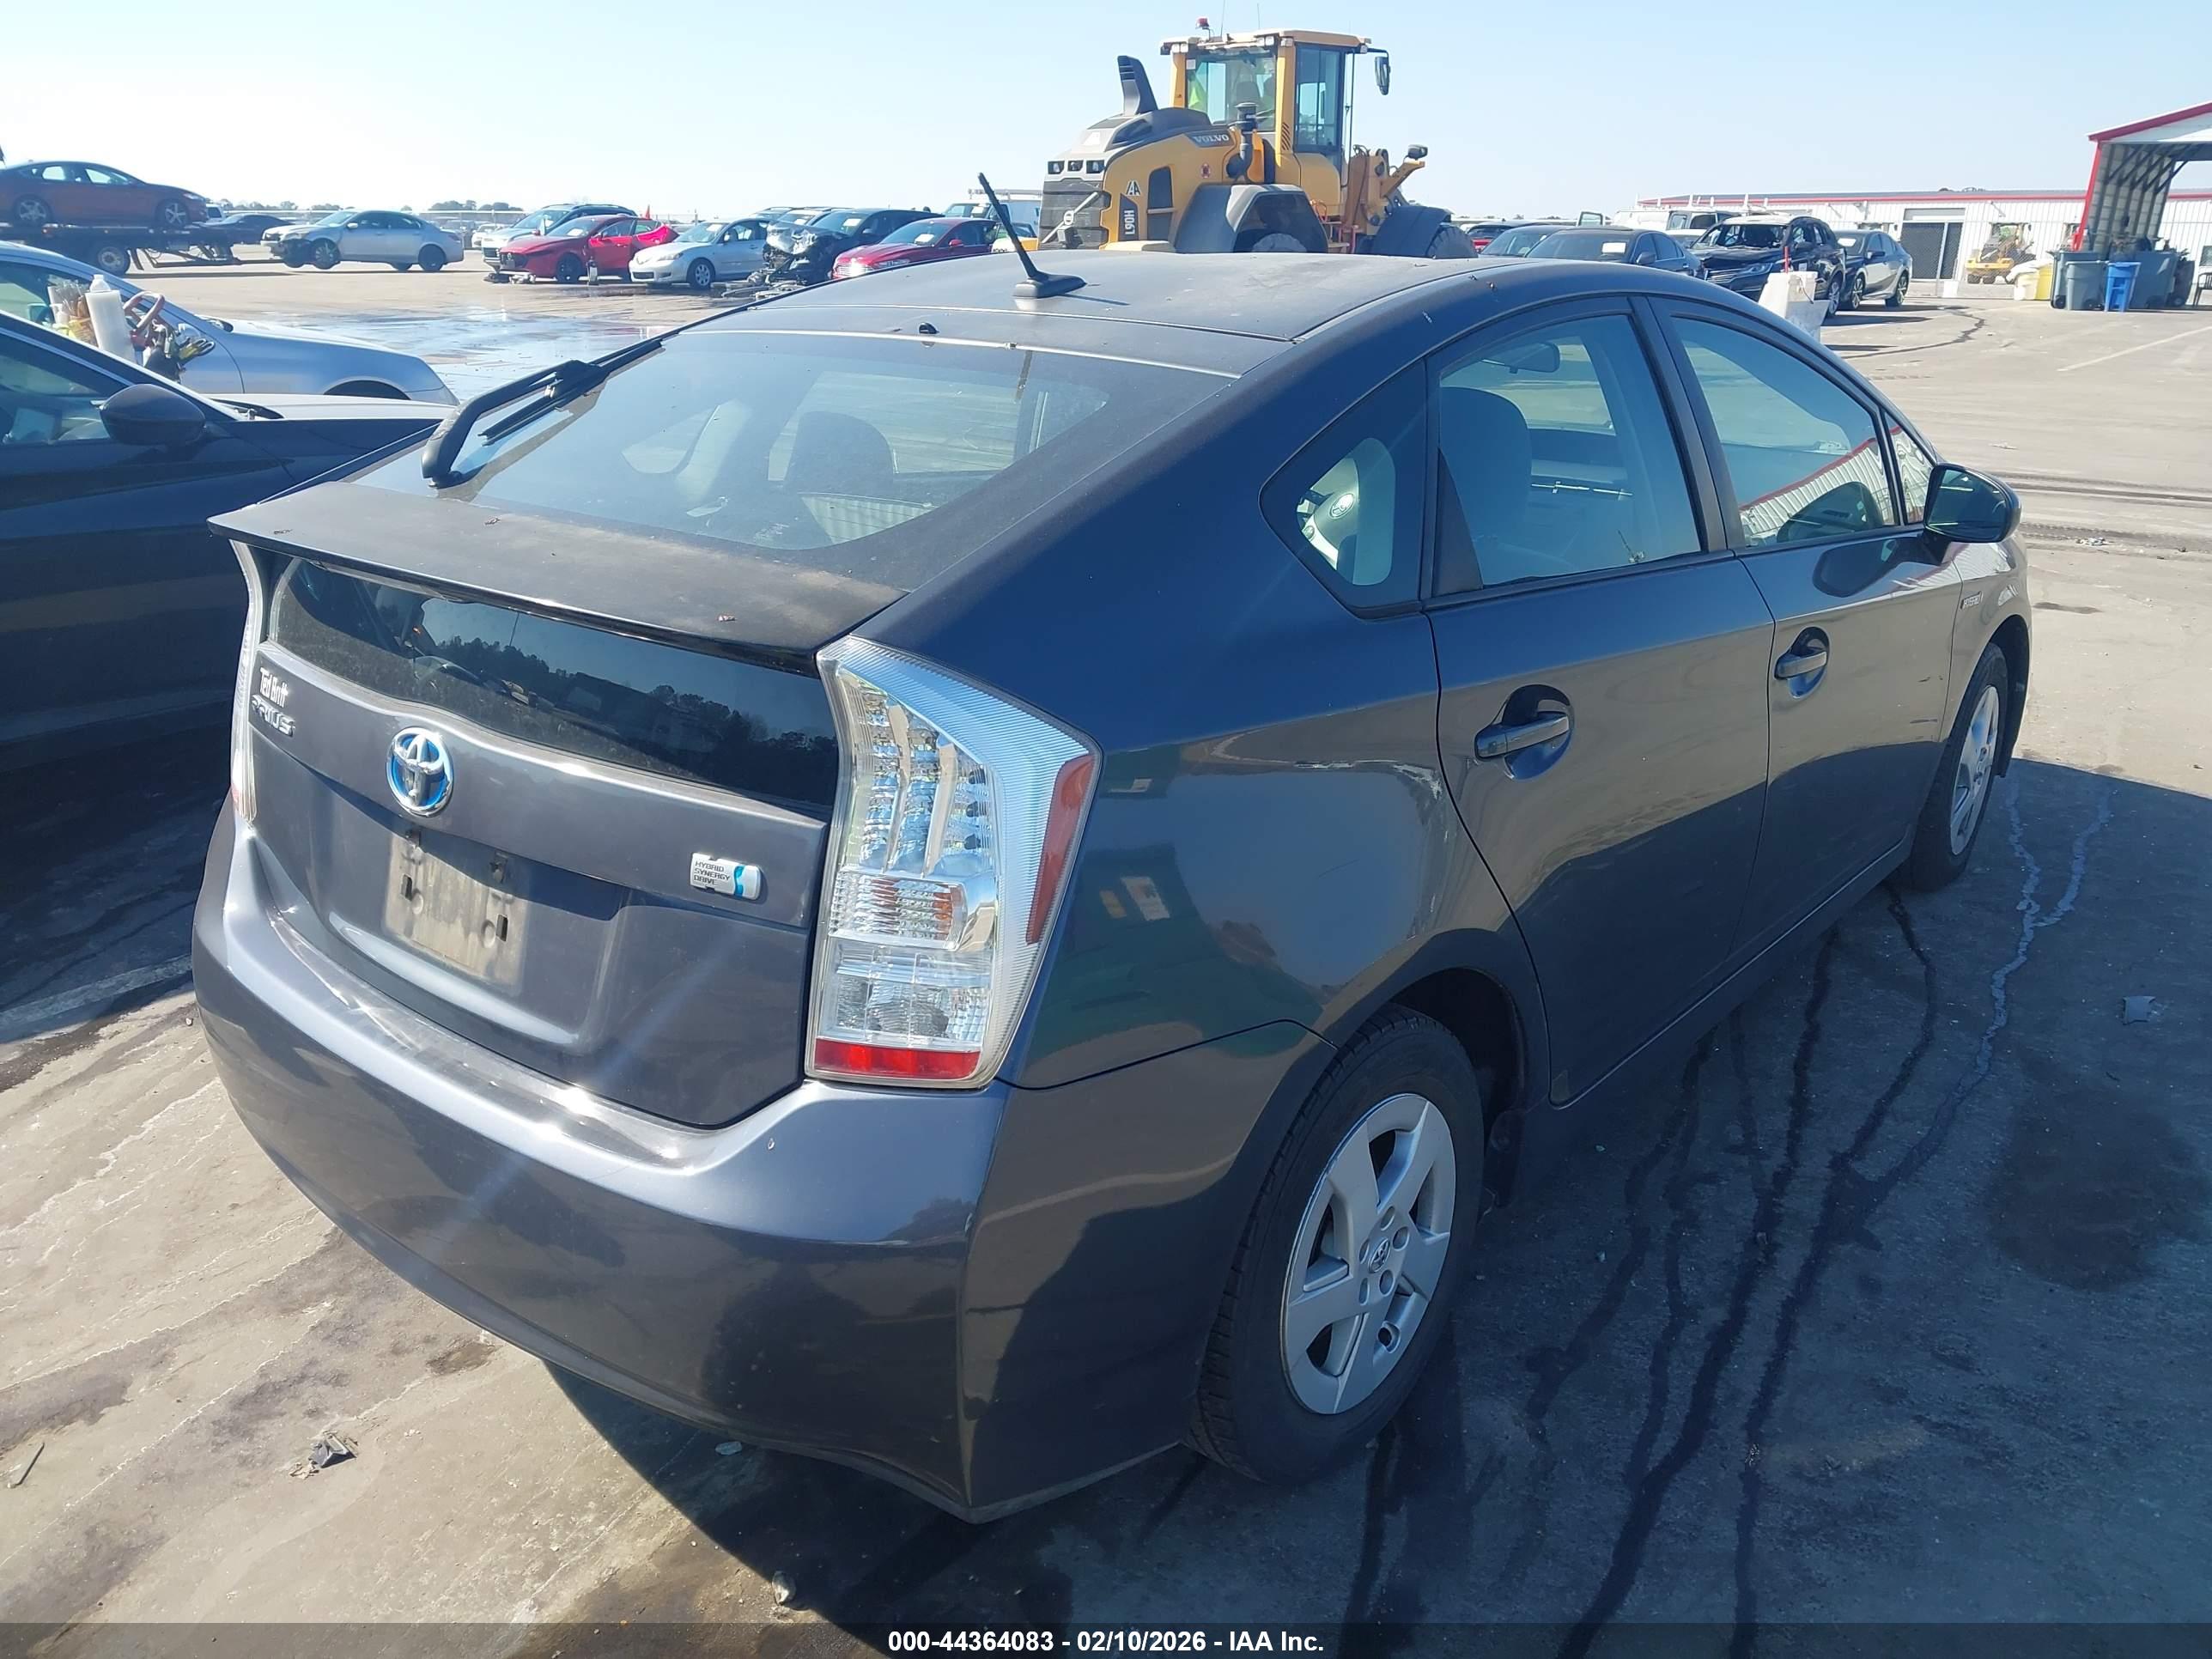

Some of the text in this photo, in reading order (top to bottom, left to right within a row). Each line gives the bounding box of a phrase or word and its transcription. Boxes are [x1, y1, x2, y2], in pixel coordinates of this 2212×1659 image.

[1194, 134, 1230, 143] VOLVO
[1124, 210, 1135, 235] L90H
[260, 666, 272, 699] Ted
[252, 694, 296, 737] PRIUS
[696, 860, 725, 872] HYBRID
[693, 874, 718, 885] DRIVE
[694, 867, 731, 881] SYNERGY
